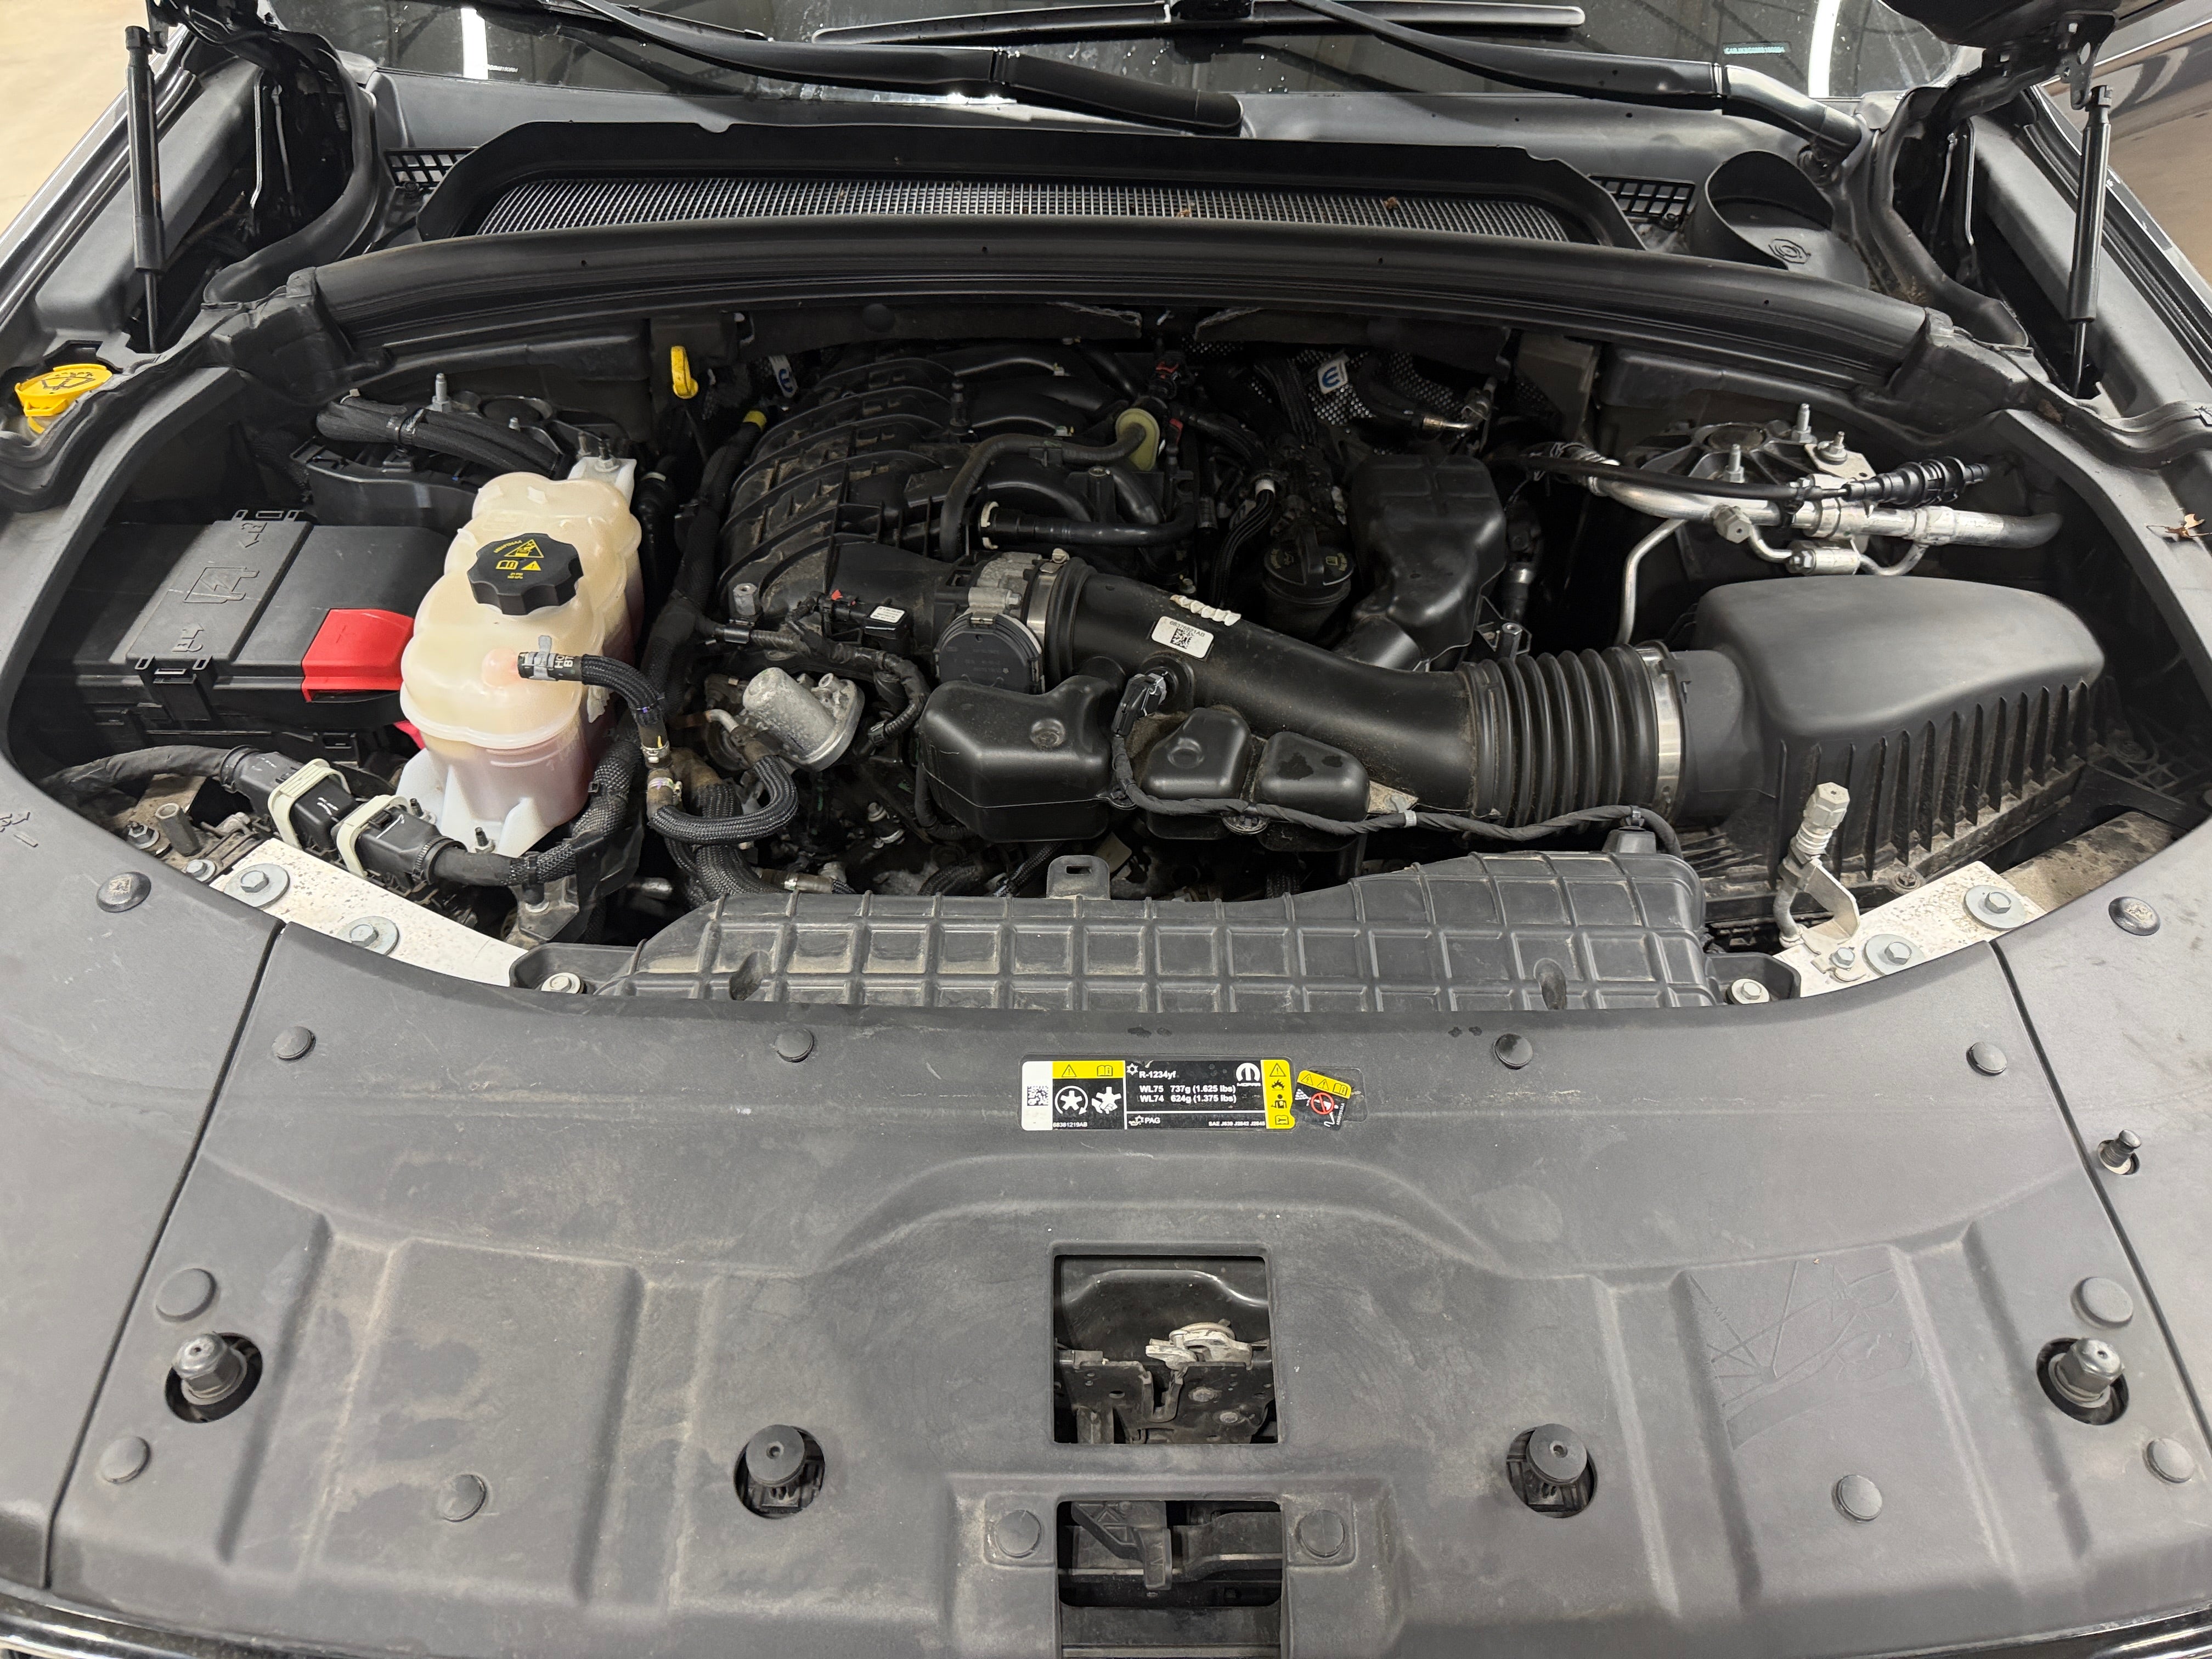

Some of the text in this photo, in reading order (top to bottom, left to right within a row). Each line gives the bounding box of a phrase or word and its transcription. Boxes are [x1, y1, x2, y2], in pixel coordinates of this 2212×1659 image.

[1139, 1070, 1176, 1080] R-1234yf
[1170, 1085, 1191, 1094] 737g
[1192, 1085, 1218, 1094] (1.625
[1220, 1085, 1236, 1094] lbs)
[1170, 1094, 1191, 1103] 624g
[1193, 1094, 1219, 1104] (1.375
[1220, 1094, 1237, 1104] lbs)
